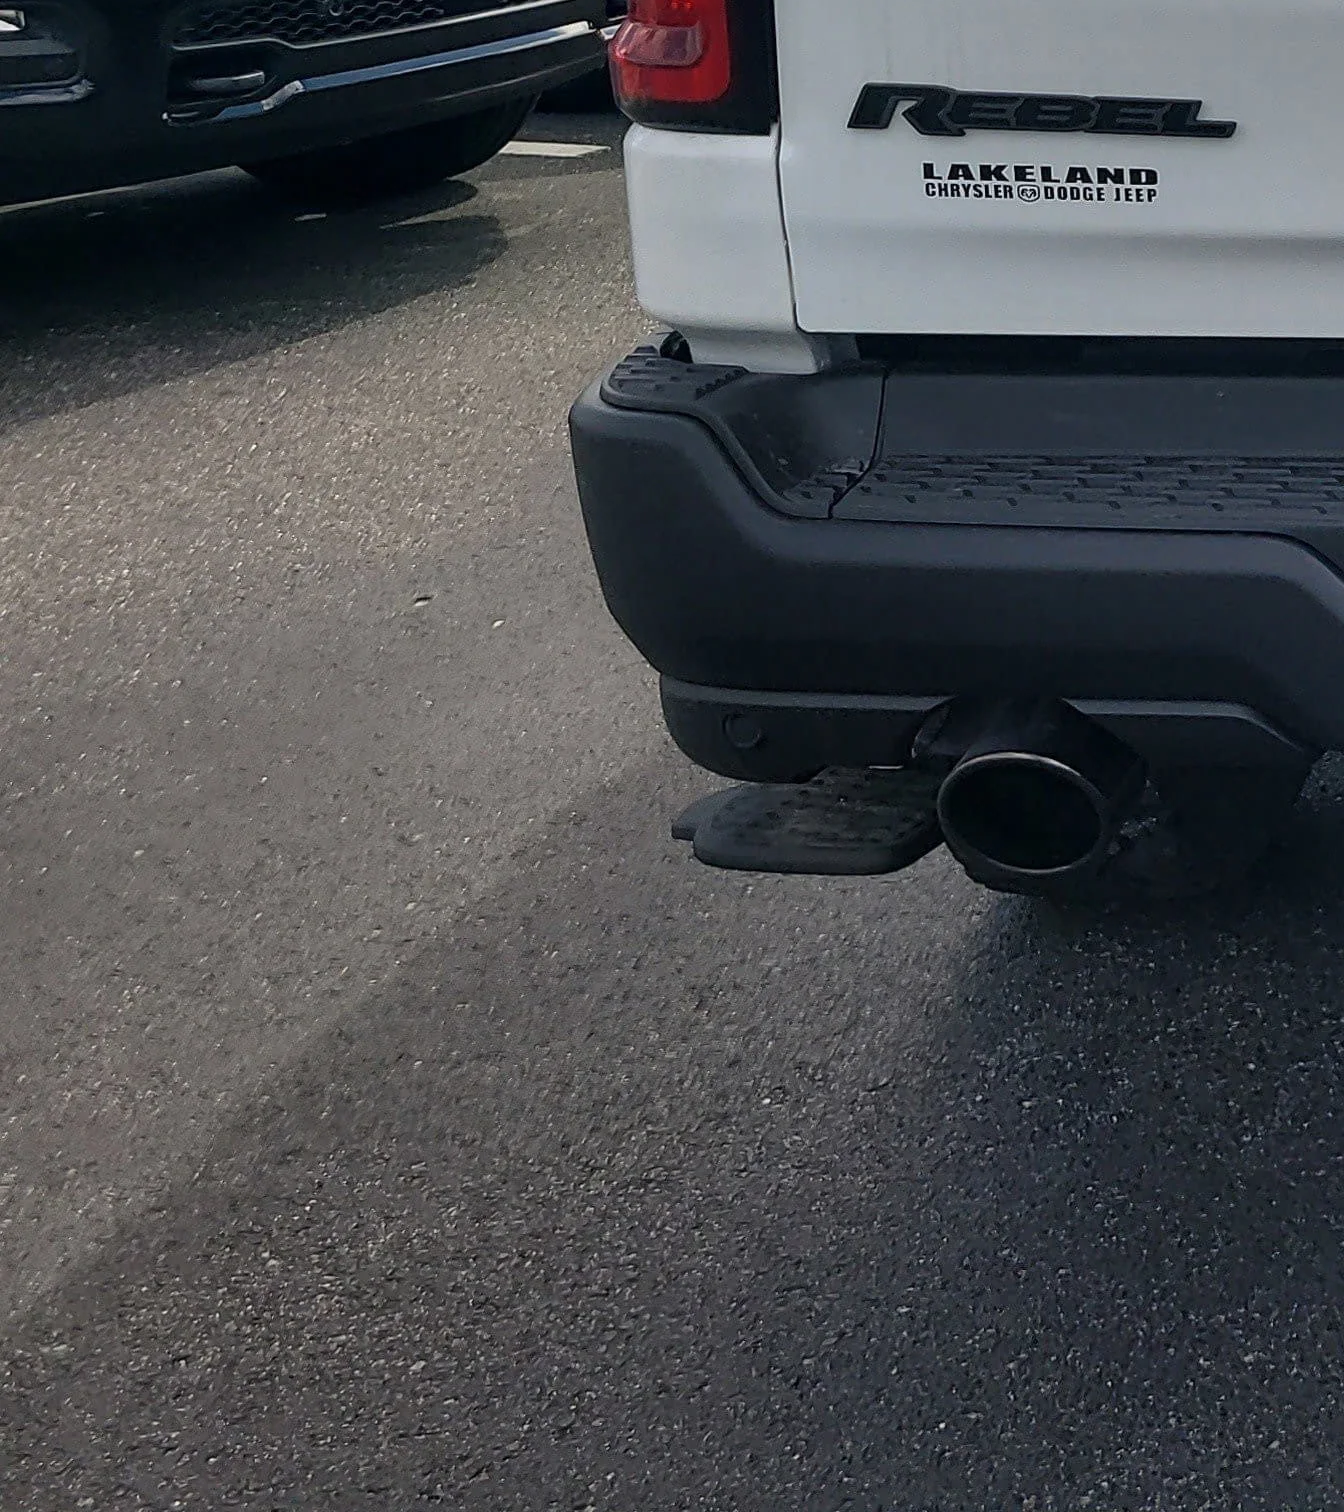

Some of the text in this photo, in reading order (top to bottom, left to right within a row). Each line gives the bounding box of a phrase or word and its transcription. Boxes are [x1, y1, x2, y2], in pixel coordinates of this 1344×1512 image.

[847, 82, 1237, 138] REBEL
[923, 163, 1158, 185] LAKELAND
[925, 183, 1157, 202] CHRYSLER DODGE JEEP
